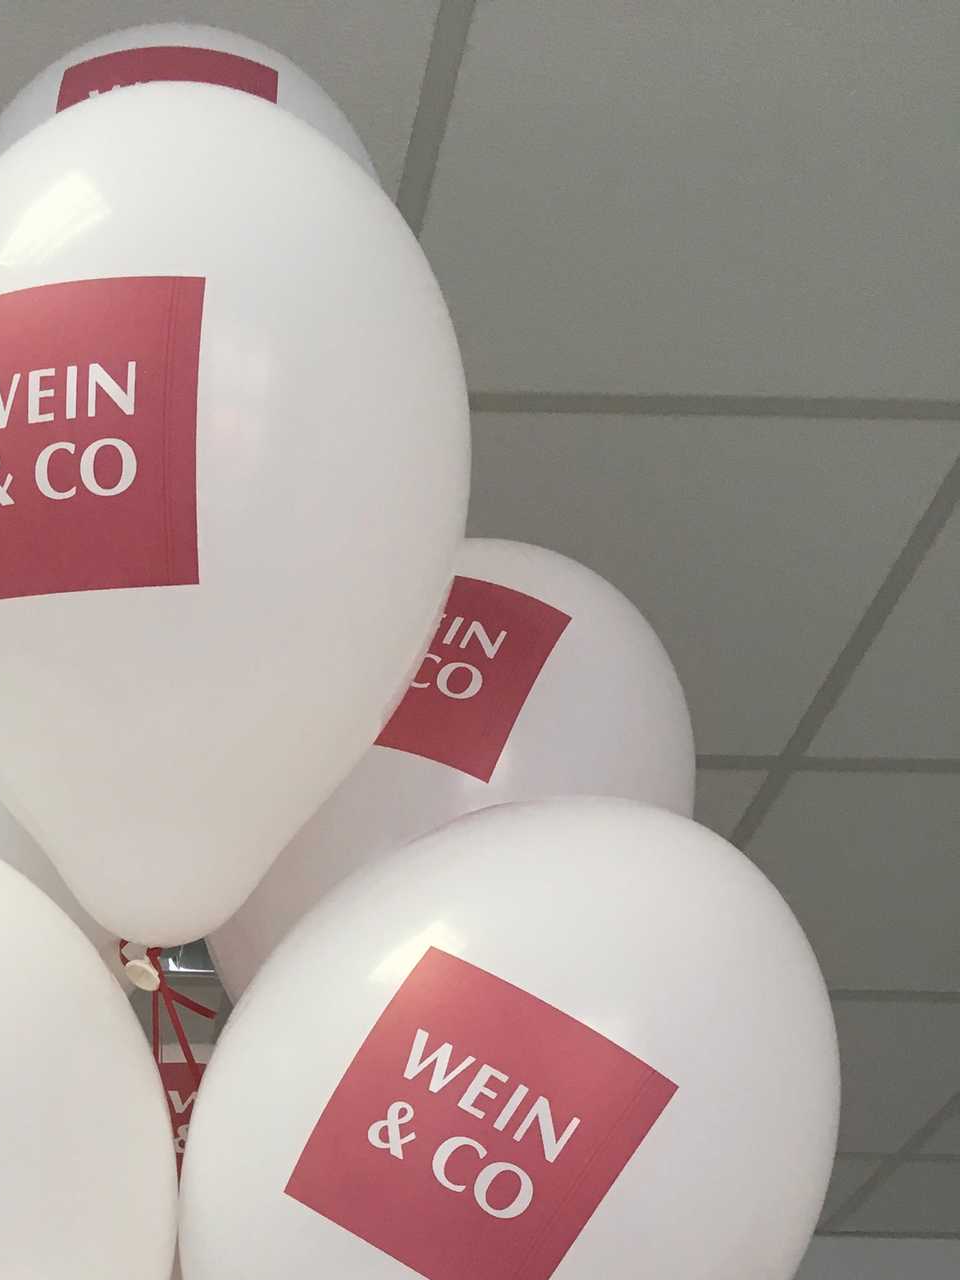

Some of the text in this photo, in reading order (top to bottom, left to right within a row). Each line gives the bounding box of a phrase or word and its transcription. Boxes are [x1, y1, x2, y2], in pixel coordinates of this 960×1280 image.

[35, 437, 138, 500] CO
[440, 614, 508, 659] IN
[403, 1028, 581, 1164] WEIN
[367, 1101, 534, 1219] & CO
